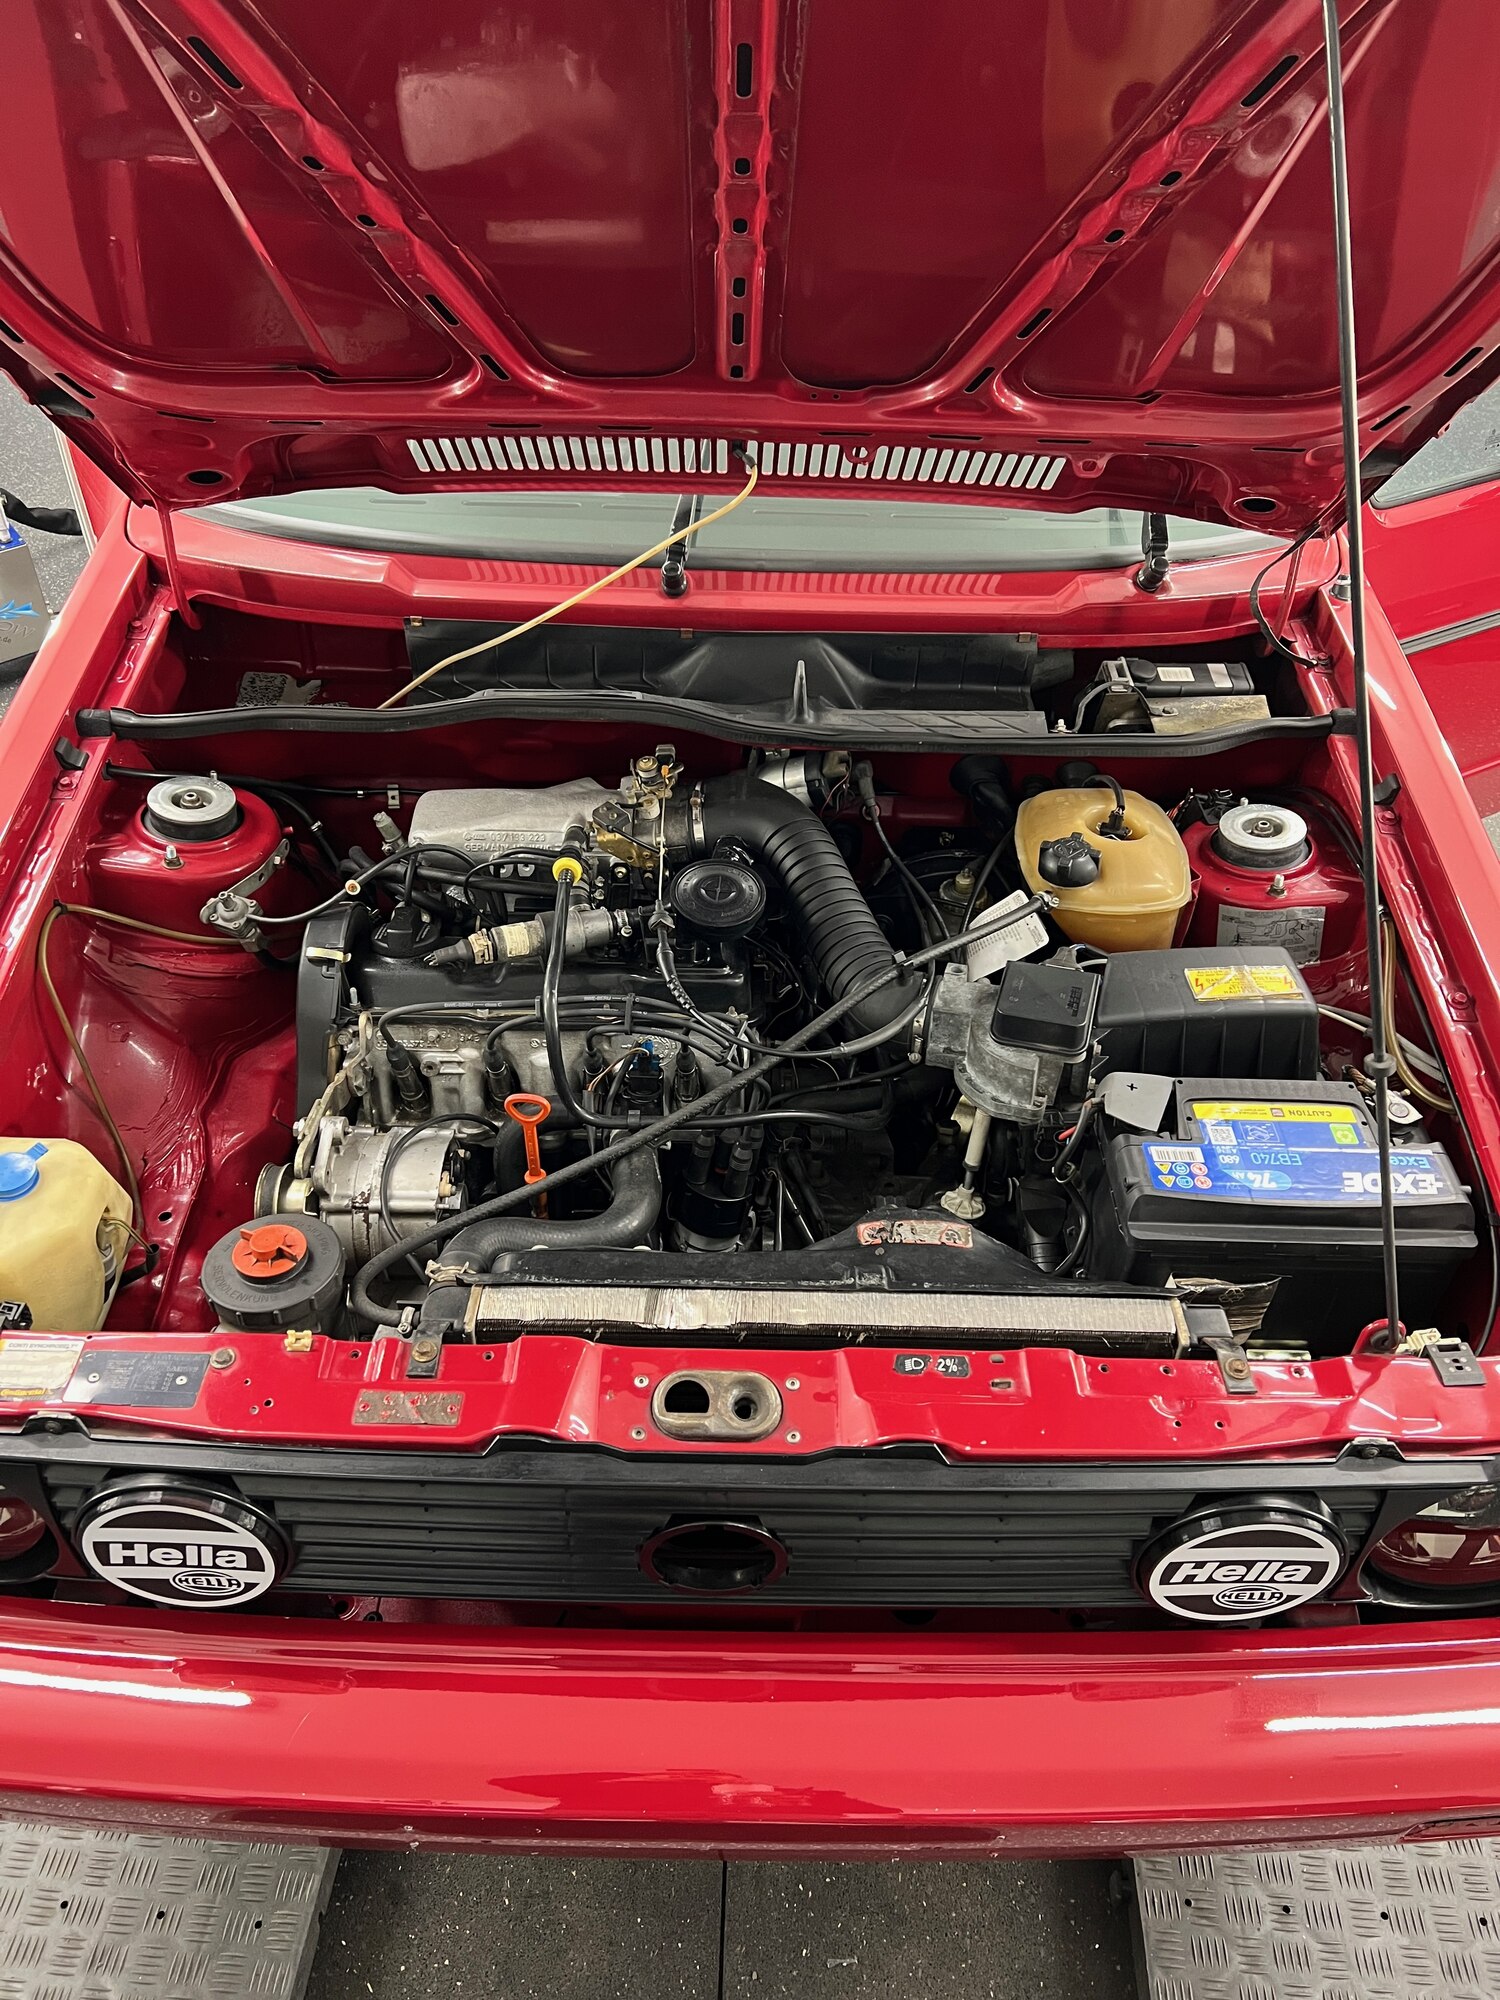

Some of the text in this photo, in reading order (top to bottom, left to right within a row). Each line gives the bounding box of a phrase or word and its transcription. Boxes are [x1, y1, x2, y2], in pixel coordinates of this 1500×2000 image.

[528, 833, 546, 842] 223
[1288, 1108, 1333, 1117] CAUTION
[1218, 1155, 1240, 1164] 680
[1250, 1152, 1303, 1166] EB740
[1246, 1171, 1278, 1189] 74
[937, 1359, 958, 1372] 2%
[108, 1543, 248, 1569] Hella
[1169, 1561, 1313, 1583] Hella
[178, 1576, 242, 1589] HELLA
[1220, 1591, 1285, 1602] HELLA
